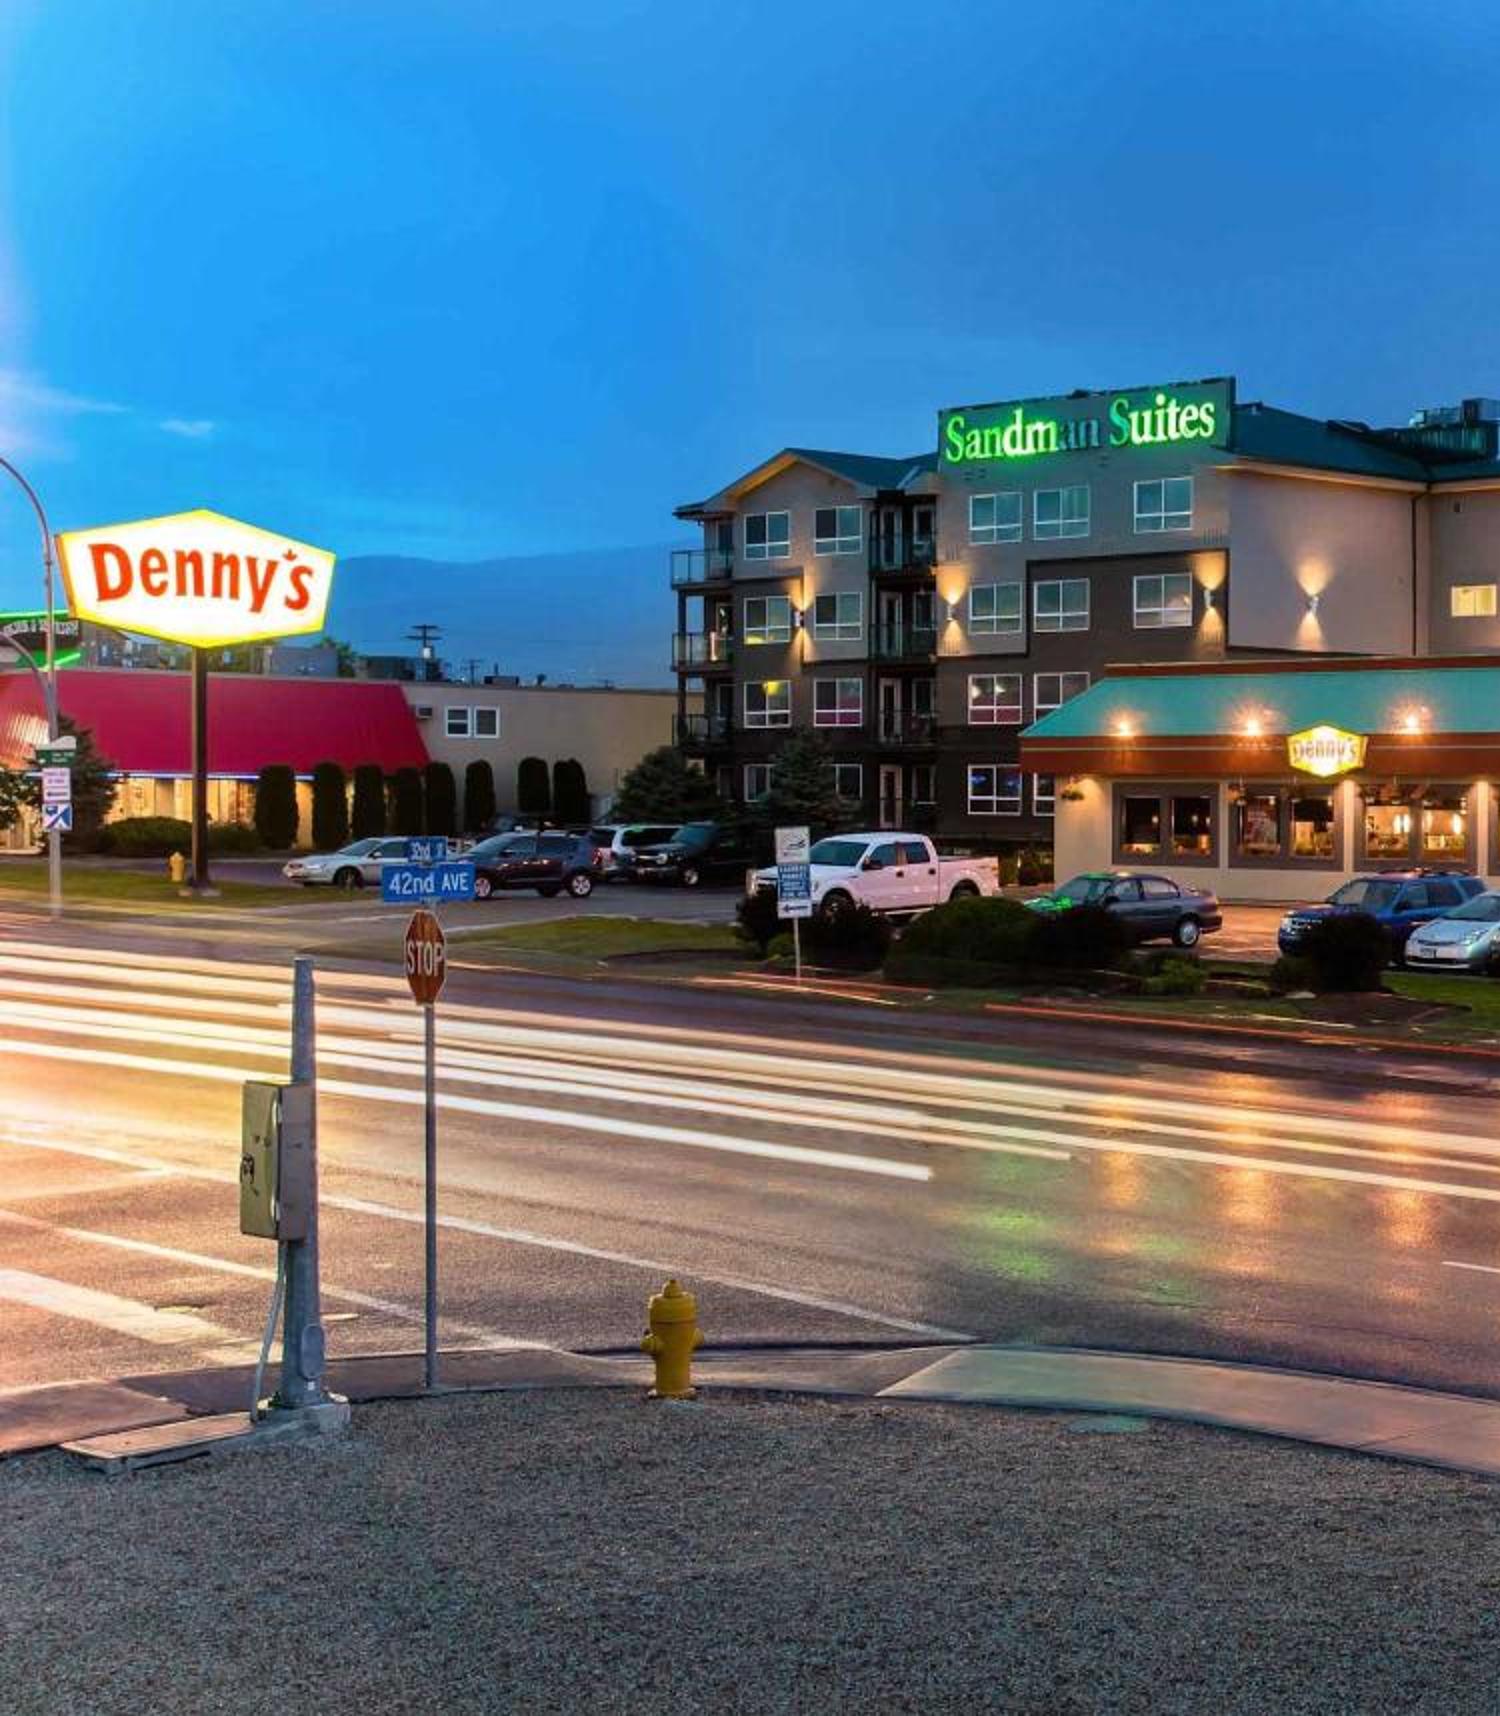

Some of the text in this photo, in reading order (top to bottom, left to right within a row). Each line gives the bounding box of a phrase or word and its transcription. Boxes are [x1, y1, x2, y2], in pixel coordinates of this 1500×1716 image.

[945, 394, 1215, 462] Sandman Suites
[88, 543, 314, 613] Denny's
[388, 871, 470, 895] 42nd AVE
[406, 940, 443, 977] STOP
